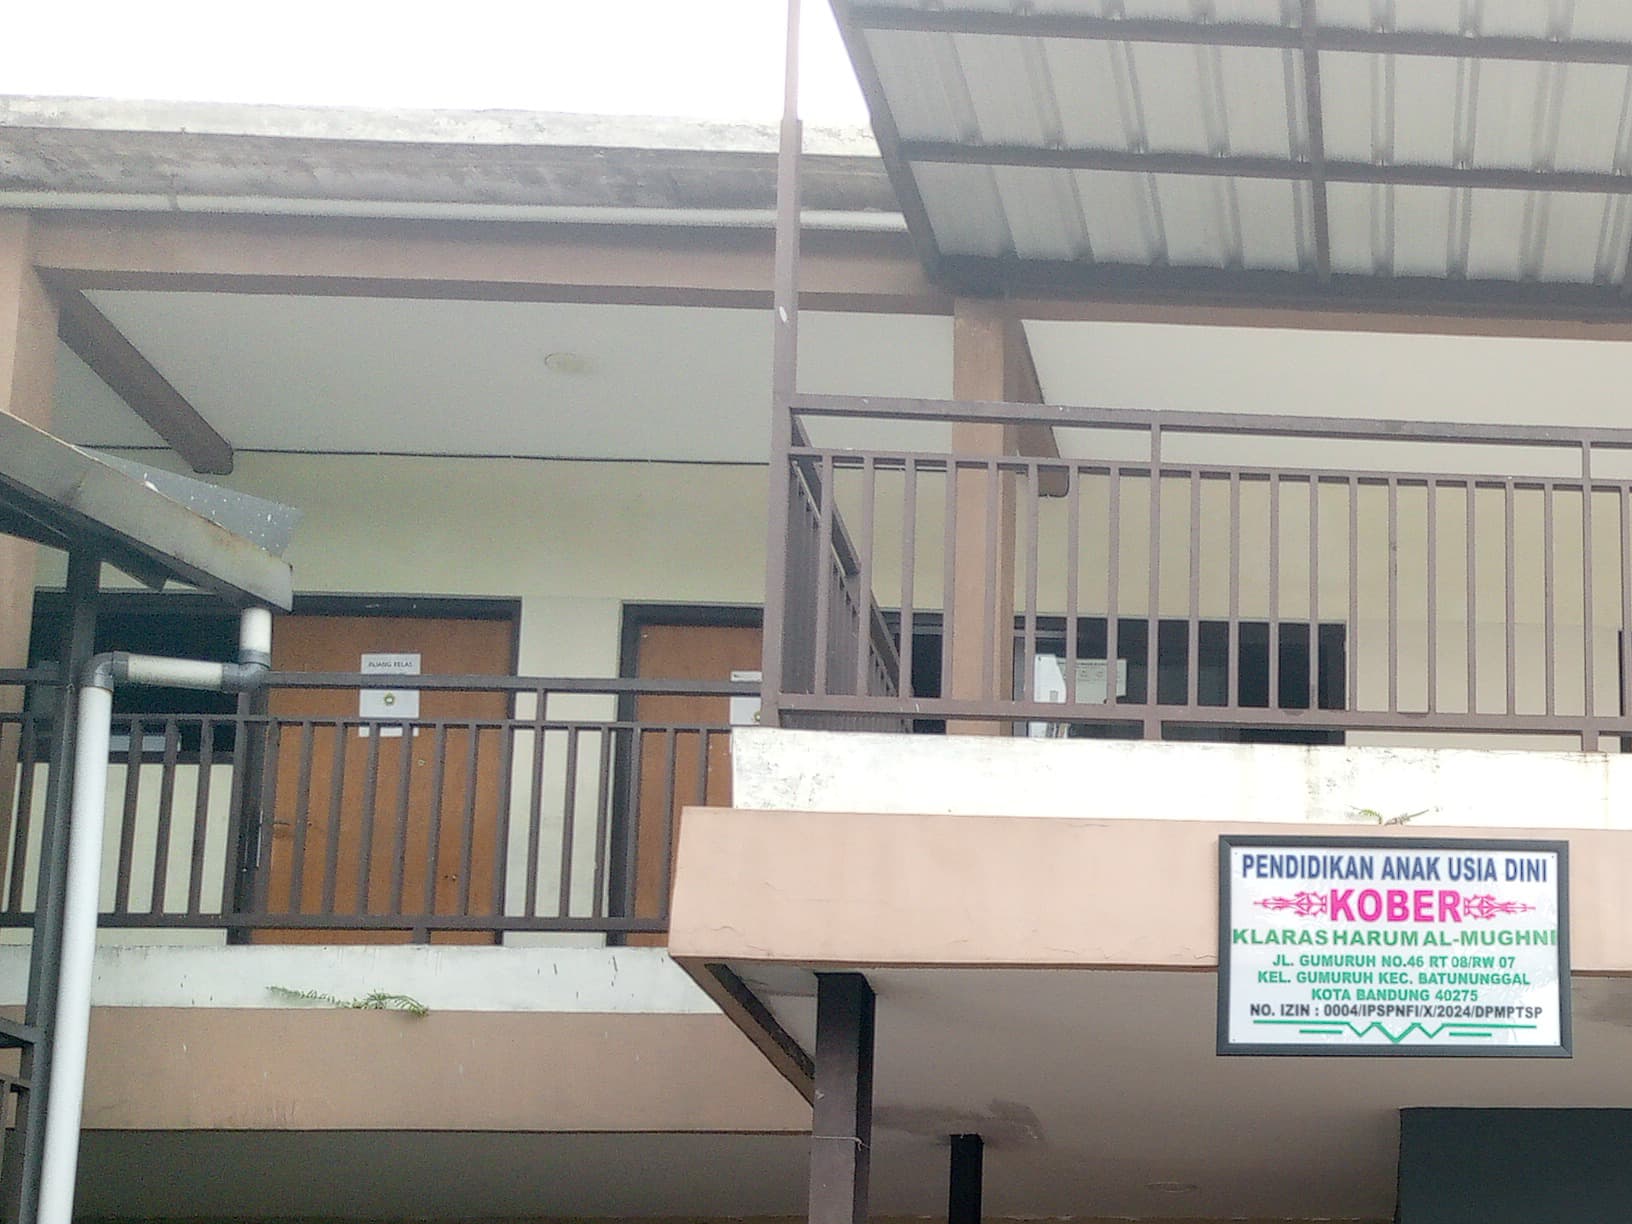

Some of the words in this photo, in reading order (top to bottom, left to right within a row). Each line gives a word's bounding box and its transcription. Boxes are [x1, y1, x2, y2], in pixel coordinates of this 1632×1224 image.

[1242, 854, 1374, 879] PENDIDIKAN
[1381, 856, 1441, 881] ANAK
[1448, 857, 1498, 882] USIA
[1505, 858, 1547, 883] DINI
[1330, 889, 1462, 923] KOBER
[1233, 929, 1328, 945] KLARAS
[1333, 930, 1419, 946] HARUM
[1423, 930, 1557, 946] AL-MUGHNI
[1272, 954, 1294, 967] JL.
[1299, 955, 1376, 967] GUMURUH
[1382, 955, 1424, 968] NO.46
[1429, 956, 1448, 968] RT
[1451, 956, 1495, 969] 08/RW
[1499, 956, 1516, 969] 07
[1257, 971, 1291, 983] KEL.
[1296, 971, 1373, 984] GUMURUH
[1379, 972, 1413, 985] KEC.
[1418, 973, 1530, 985] BATUNUNGGAL
[1311, 988, 1351, 1001] KOTA
[1356, 989, 1430, 1001] BANDUNG
[1435, 990, 1479, 1002] 40275
[1250, 1003, 1275, 1017] NO.
[1280, 1004, 1310, 1017] IZIN
[1324, 1004, 1543, 1019] 0004/IPSPNFI/X/2024/DPMPTSP
